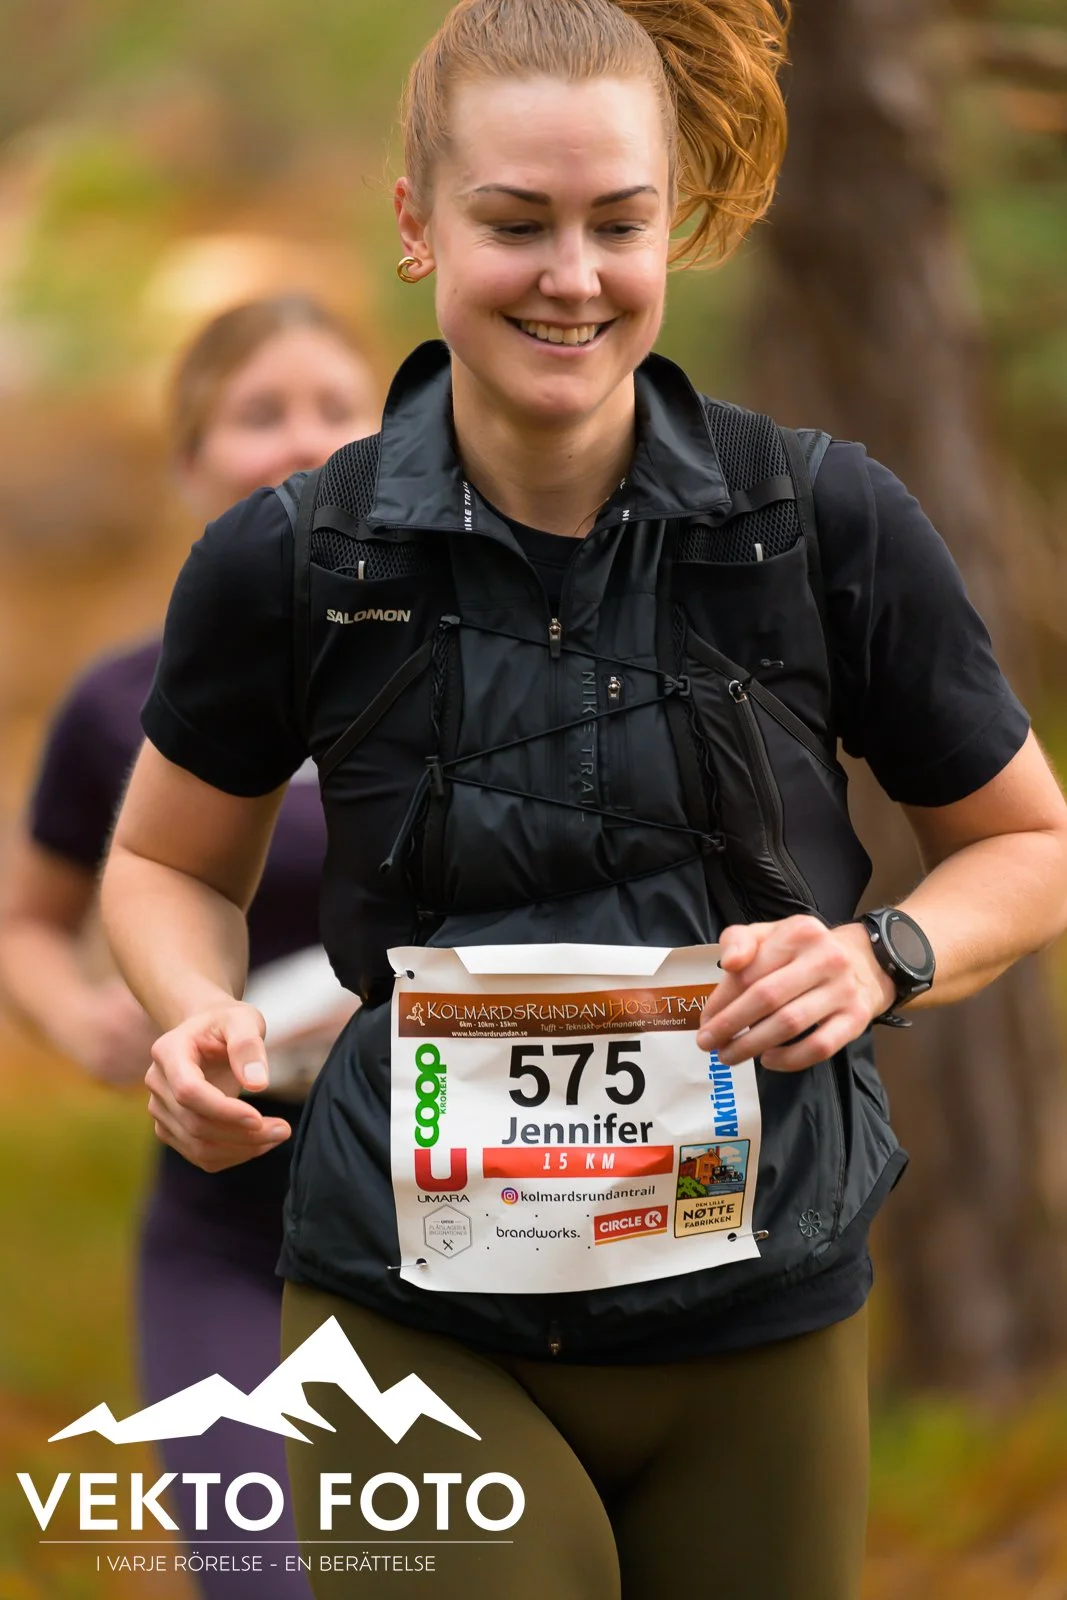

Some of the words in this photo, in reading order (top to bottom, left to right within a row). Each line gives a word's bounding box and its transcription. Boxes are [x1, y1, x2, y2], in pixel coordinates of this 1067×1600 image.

[326, 608, 411, 625] SALOMON
[582, 671, 597, 733] NIKE
[508, 1040, 646, 1108] 575
[415, 1043, 447, 1148] coop
[501, 1112, 653, 1145] Jennifer
[417, 1194, 470, 1203] UMARA
[520, 1185, 655, 1202] kolmardsrundantrail
[683, 1203, 735, 1221] NØTTE
[599, 1215, 642, 1233] CIRCLE
[684, 1215, 732, 1229] FABRIKKEN
[496, 1226, 581, 1239] brandworks.
